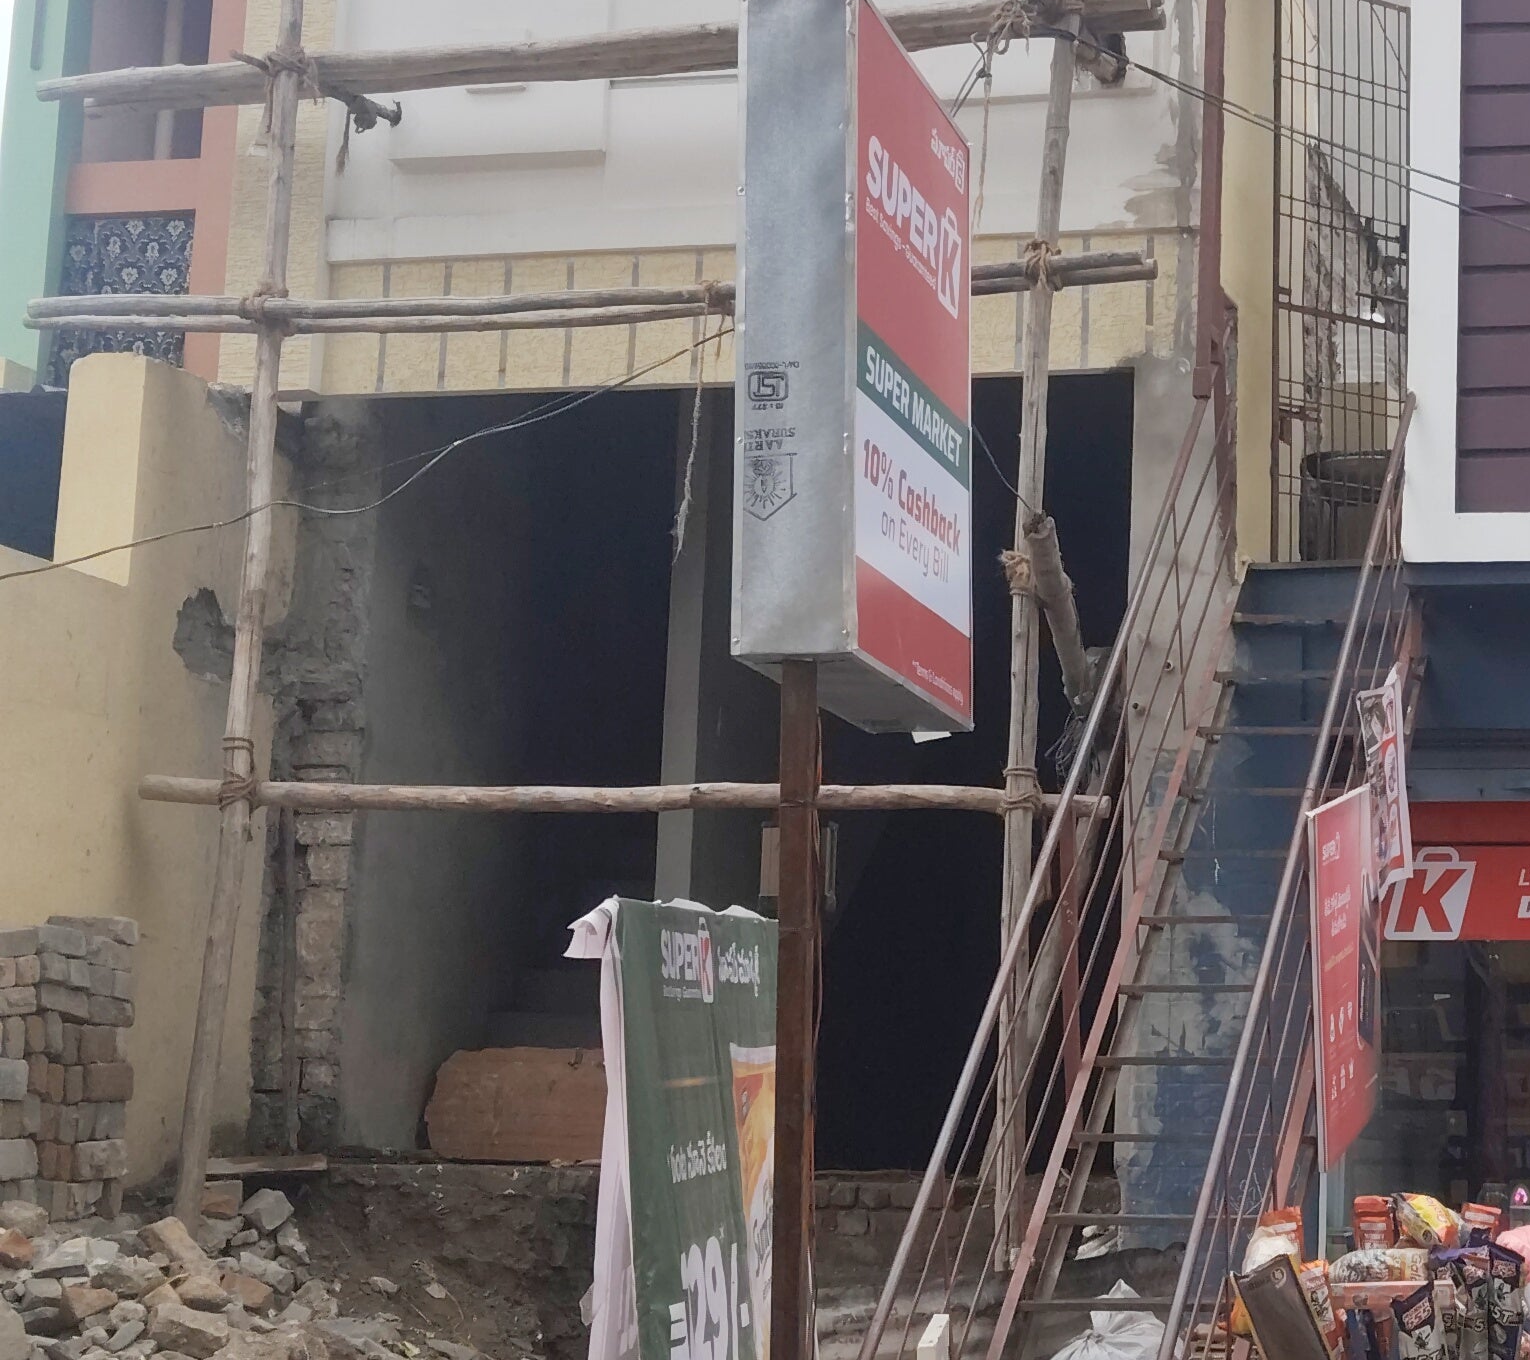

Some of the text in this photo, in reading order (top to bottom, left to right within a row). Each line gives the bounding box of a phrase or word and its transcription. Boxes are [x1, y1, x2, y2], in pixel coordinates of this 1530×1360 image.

[866, 135, 937, 269] SUPER
[865, 345, 963, 467] SUPER MARKET
[863, 438, 961, 556] 10% Cashback
[881, 511, 949, 584] on Every Bill
